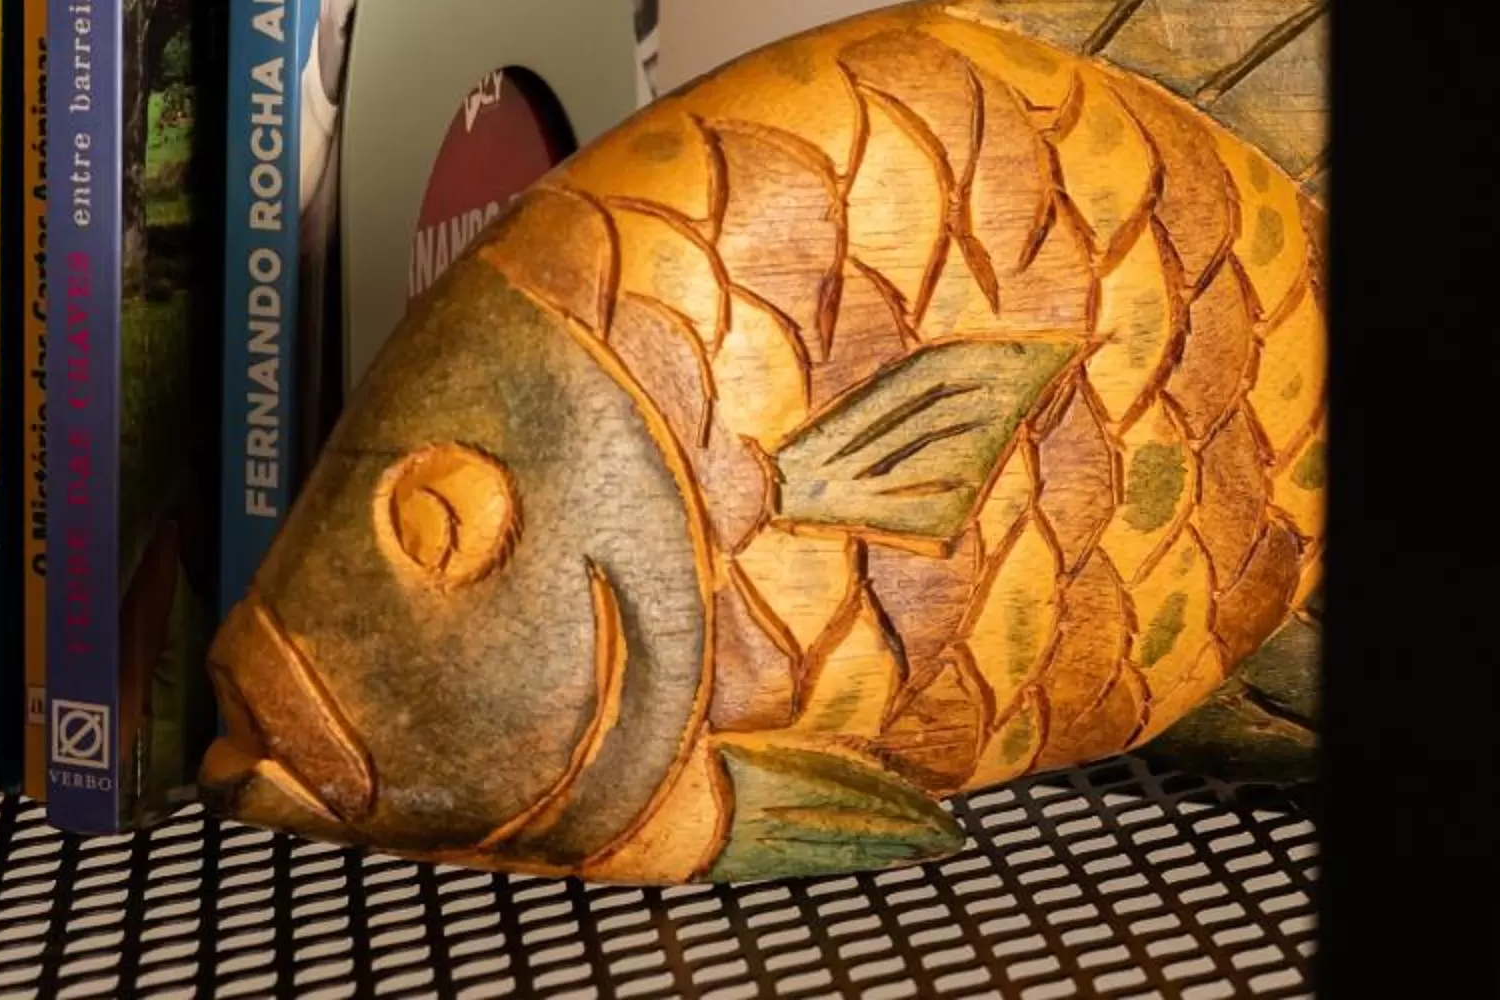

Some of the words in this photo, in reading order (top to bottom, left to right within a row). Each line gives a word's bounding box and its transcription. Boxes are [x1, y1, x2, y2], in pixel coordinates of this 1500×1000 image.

[68, 131, 92, 227] entre
[248, 67, 285, 231] ROCHA
[244, 248, 282, 518] FERNANDO
[48, 768, 113, 791] VERBO
